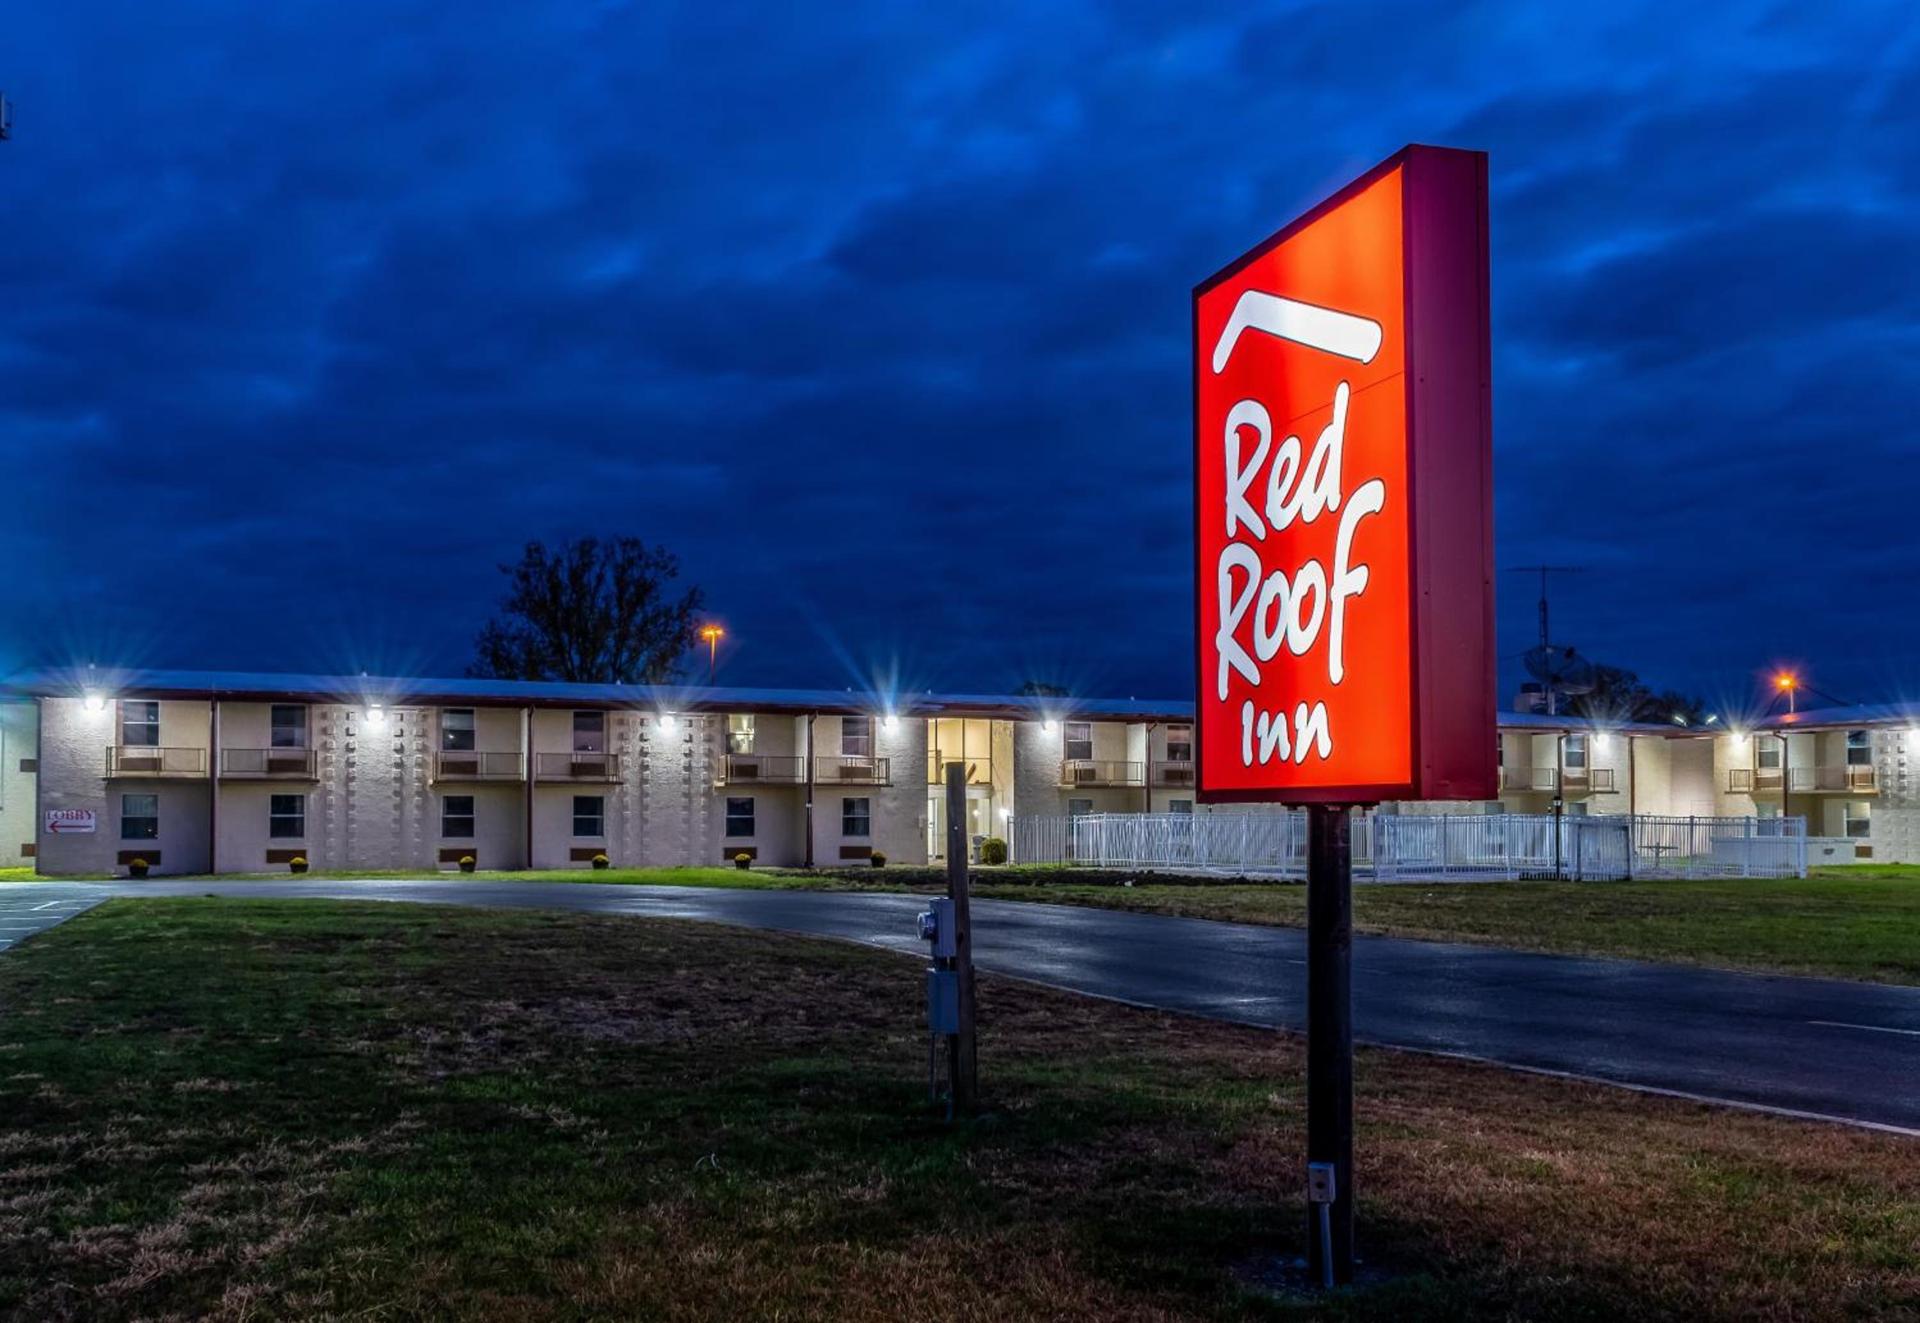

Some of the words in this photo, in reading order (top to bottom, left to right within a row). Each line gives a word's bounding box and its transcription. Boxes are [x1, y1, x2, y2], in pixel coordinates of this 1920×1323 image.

[1224, 381, 1351, 542] Red
[1216, 478, 1386, 702] Roof
[1241, 699, 1333, 767] Inn
[47, 809, 95, 820] LOBBY
